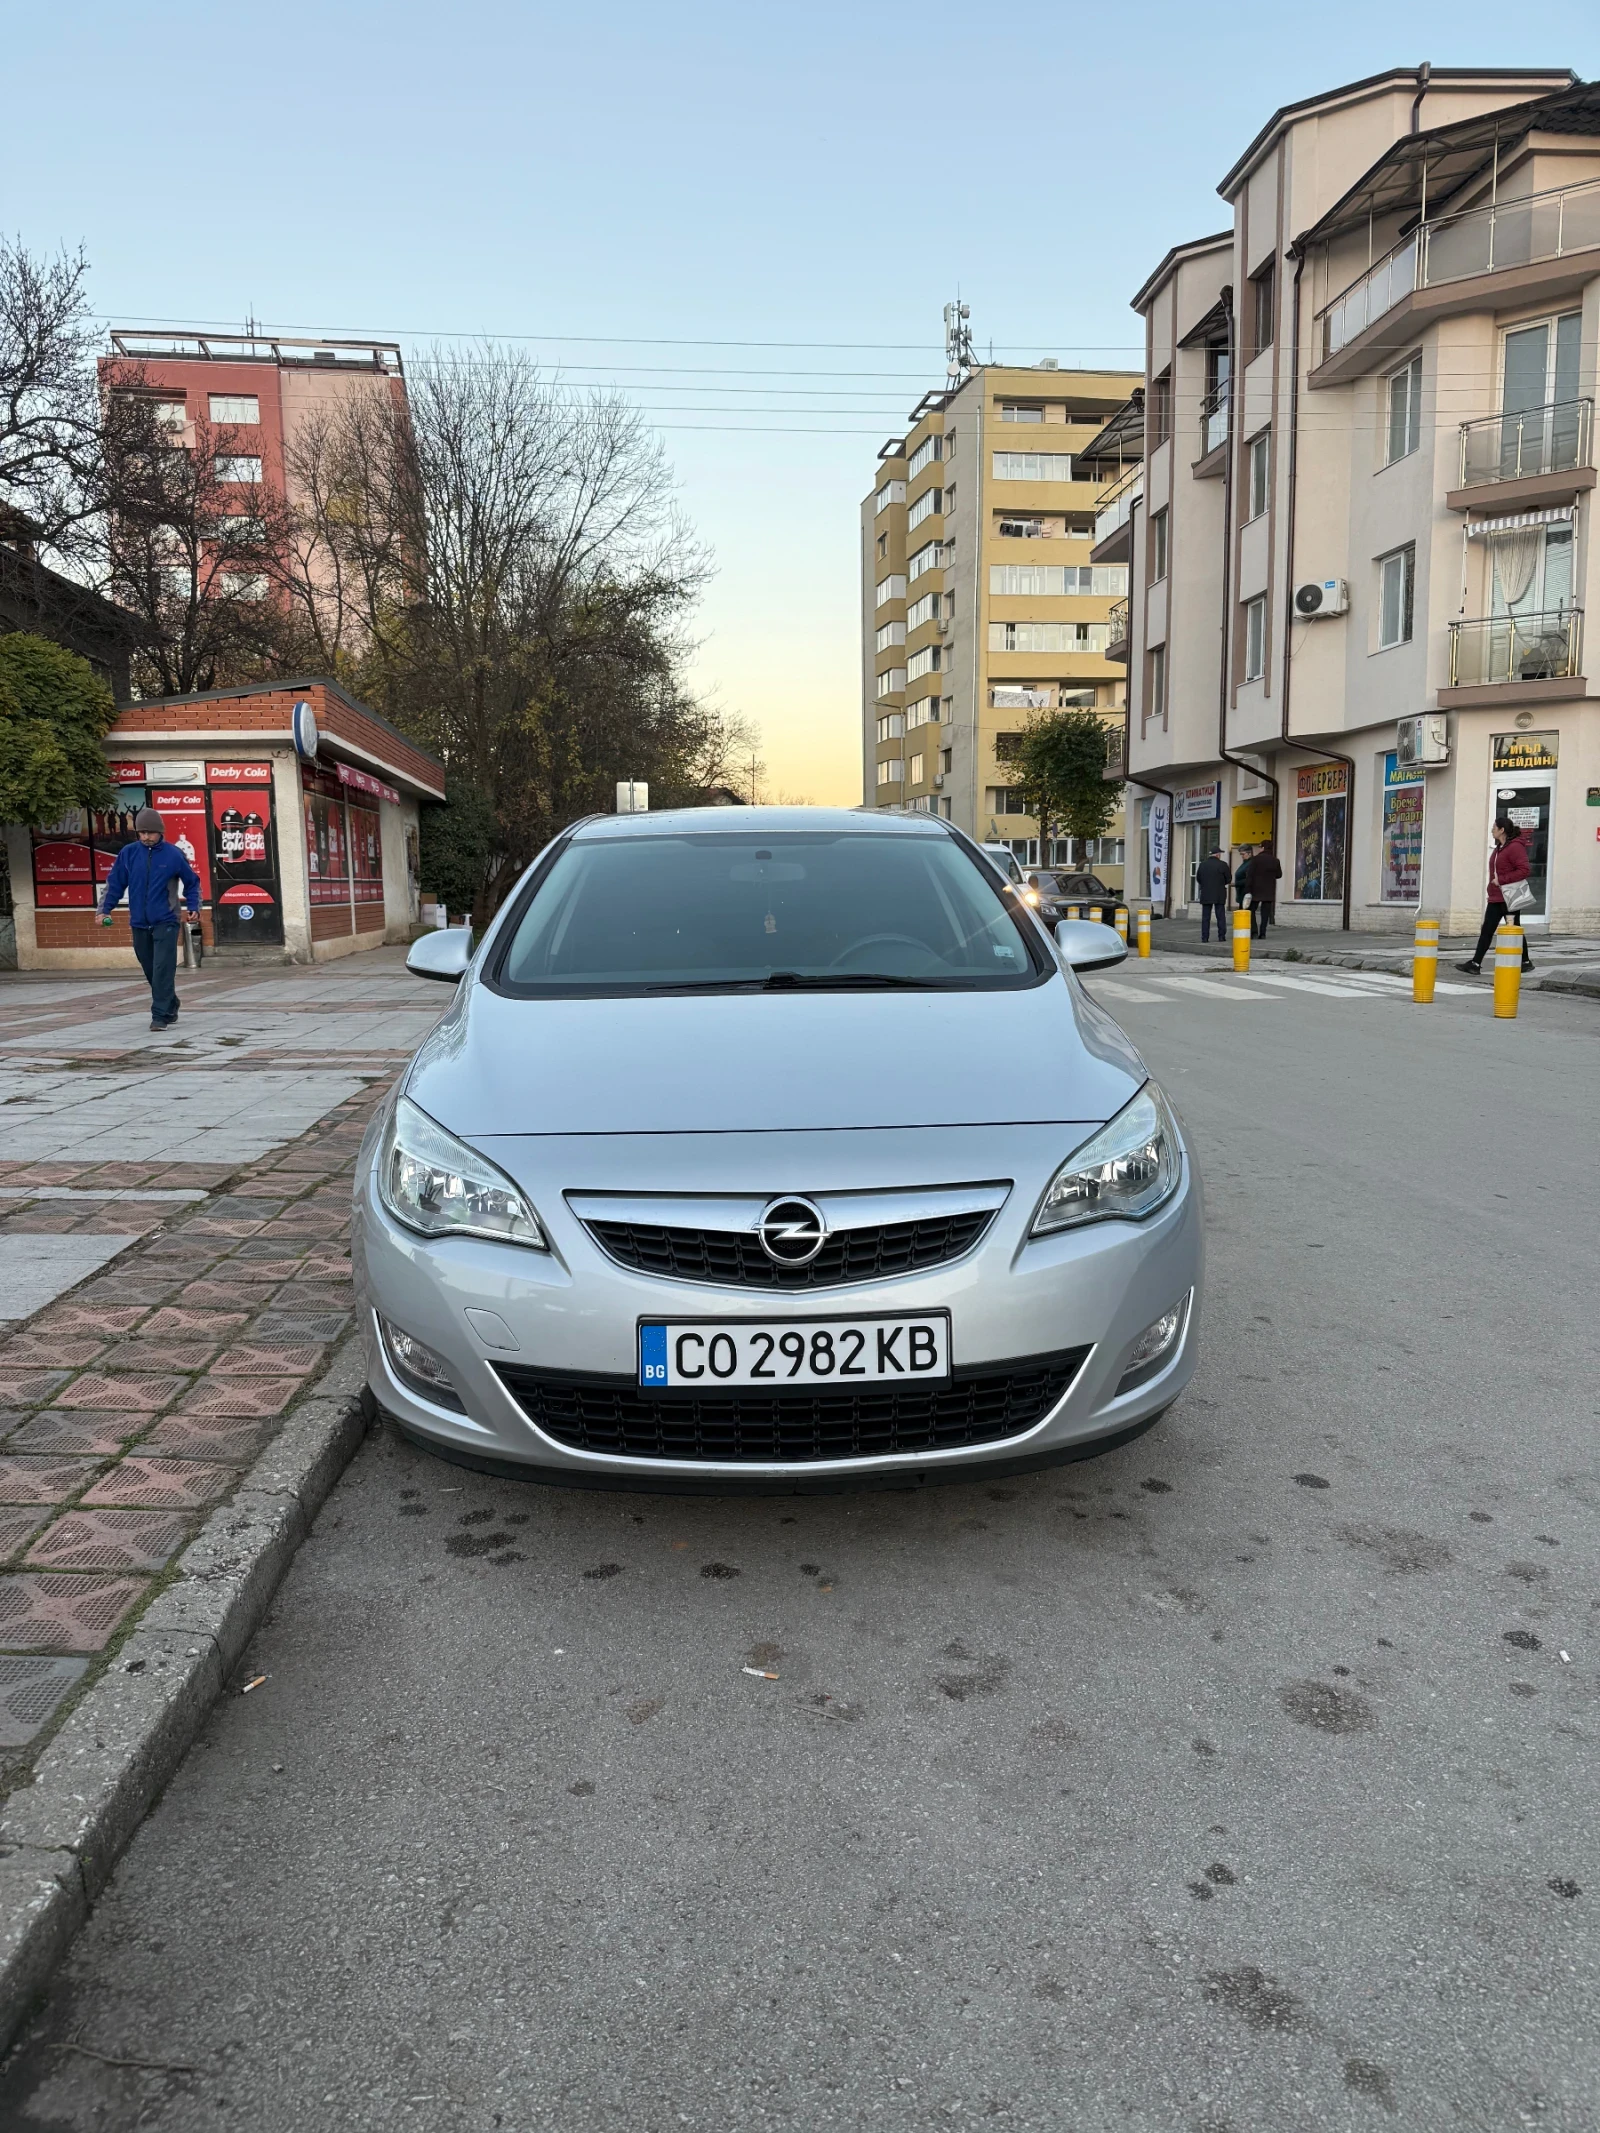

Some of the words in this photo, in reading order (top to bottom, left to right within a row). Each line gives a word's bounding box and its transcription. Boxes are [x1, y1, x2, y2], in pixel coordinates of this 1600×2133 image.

[1509, 743, 1541, 755] ИГЪЛ
[1493, 754, 1557, 768] ТРЕЙДИНГ
[121, 768, 141, 777] Cola
[210, 767, 241, 779] Derby
[244, 767, 267, 777] Cola
[1185, 785, 1215, 799] КЛИМАТИЦИ
[157, 795, 182, 806] Derby
[183, 795, 201, 804] Cola
[1390, 797, 1417, 812] Време
[1387, 813, 1396, 823] за
[1154, 806, 1165, 863] GREE
[222, 839, 244, 851] Cola
[245, 840, 265, 850] Cola
[749, 1329, 866, 1378] 2982
[645, 1364, 665, 1379] BG
